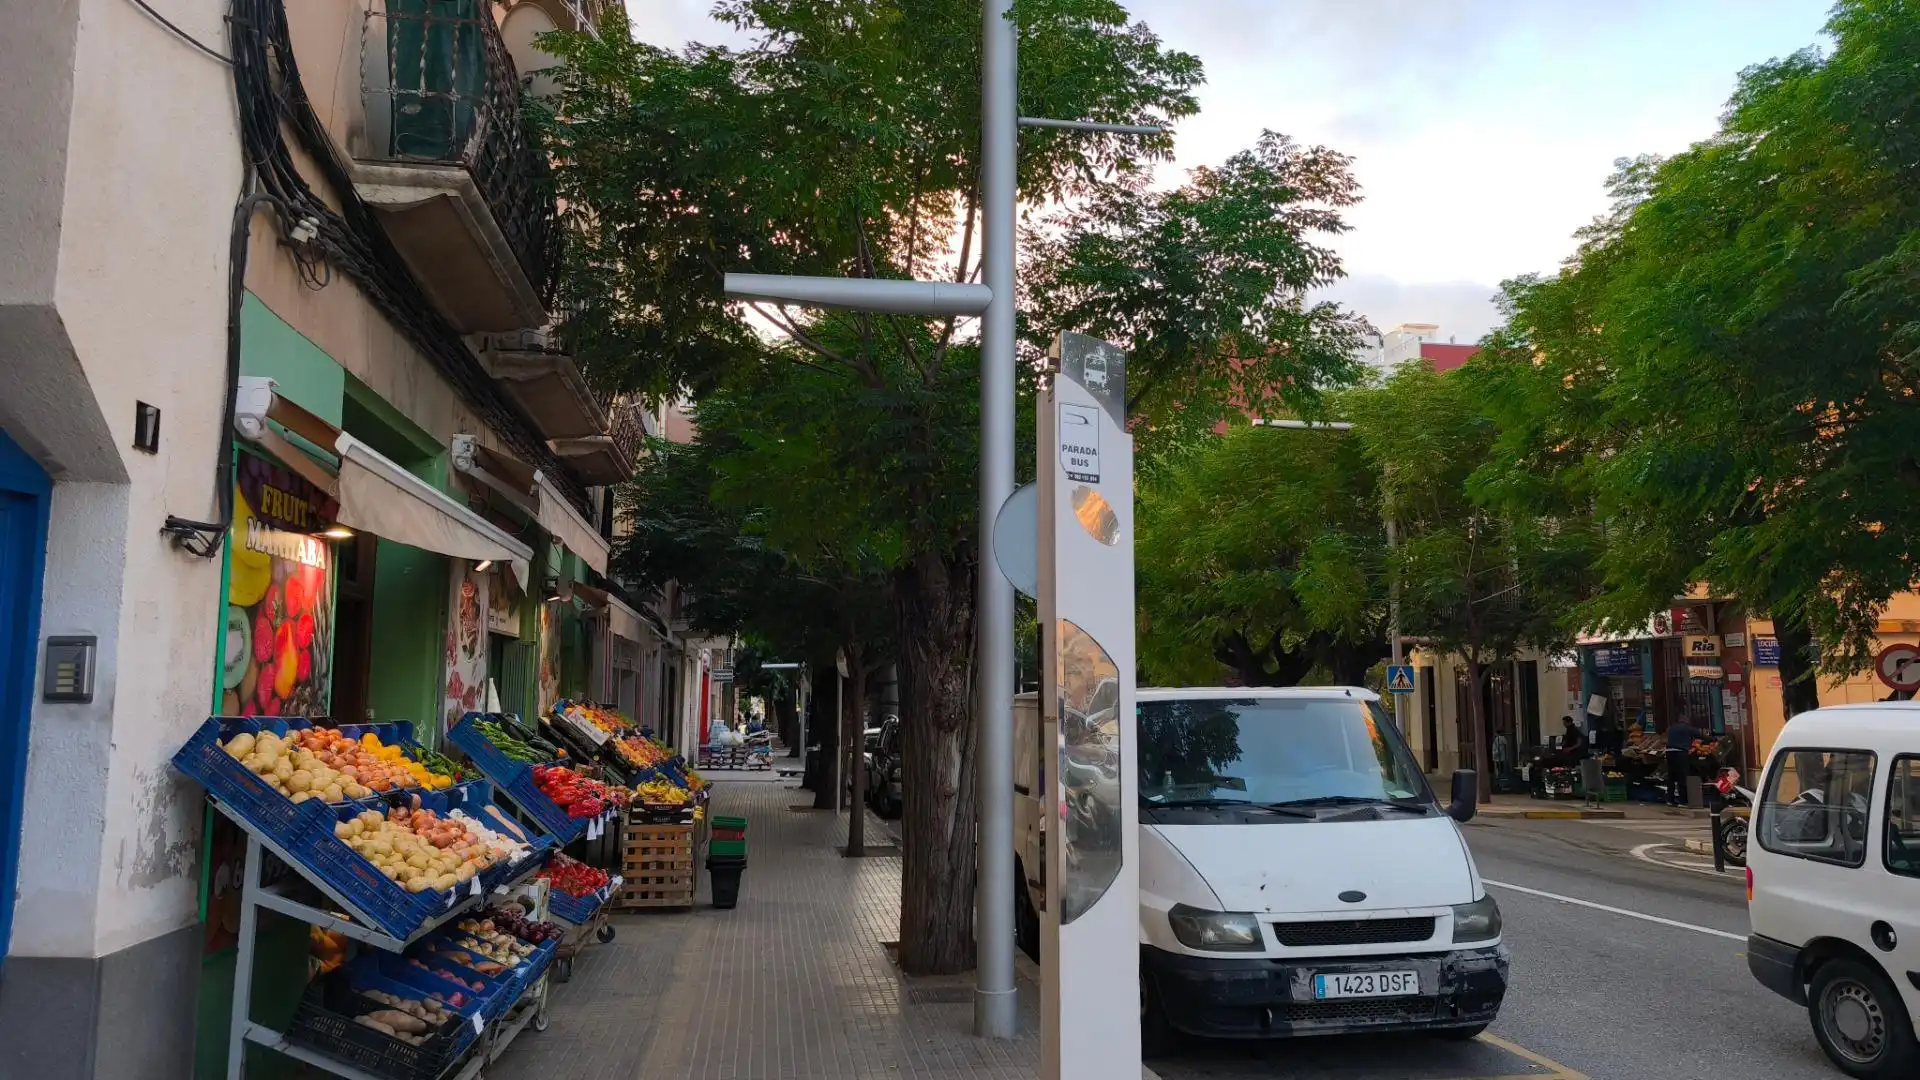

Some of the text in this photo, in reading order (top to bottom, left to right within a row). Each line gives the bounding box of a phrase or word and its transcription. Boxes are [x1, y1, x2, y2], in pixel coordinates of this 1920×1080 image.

[1062, 444, 1097, 456] PARADA
[1071, 457, 1089, 467] BUS
[1692, 637, 1715, 651] Ria
[1335, 974, 1412, 994] 1423 DSF
